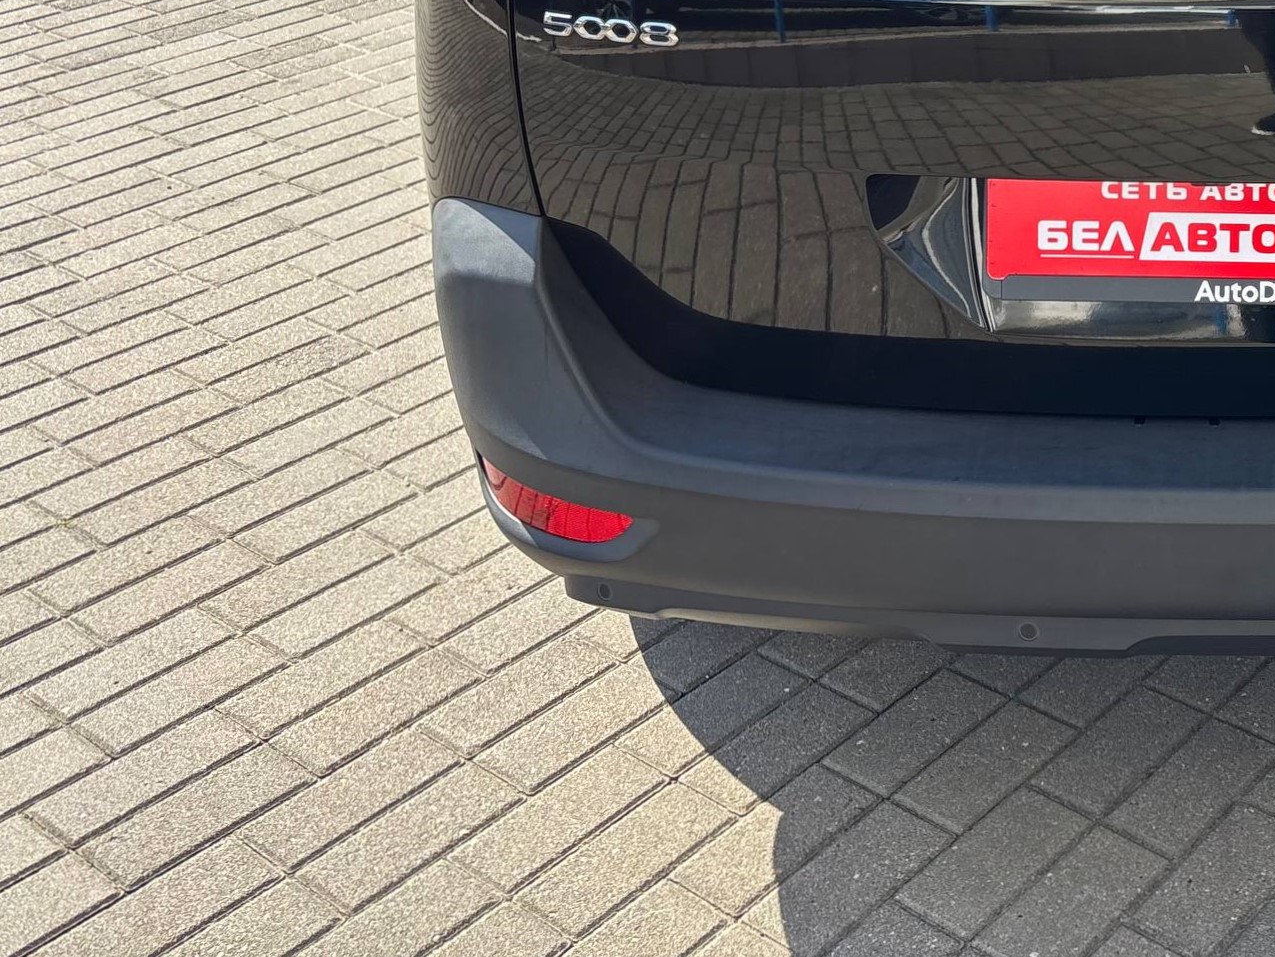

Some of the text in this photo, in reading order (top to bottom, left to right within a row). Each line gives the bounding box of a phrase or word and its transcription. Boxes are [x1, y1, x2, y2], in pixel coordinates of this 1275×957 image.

[543, 11, 680, 46] 5008
[1101, 182, 1187, 200] СЕТЬ
[1037, 220, 1135, 252] БЕЛ
